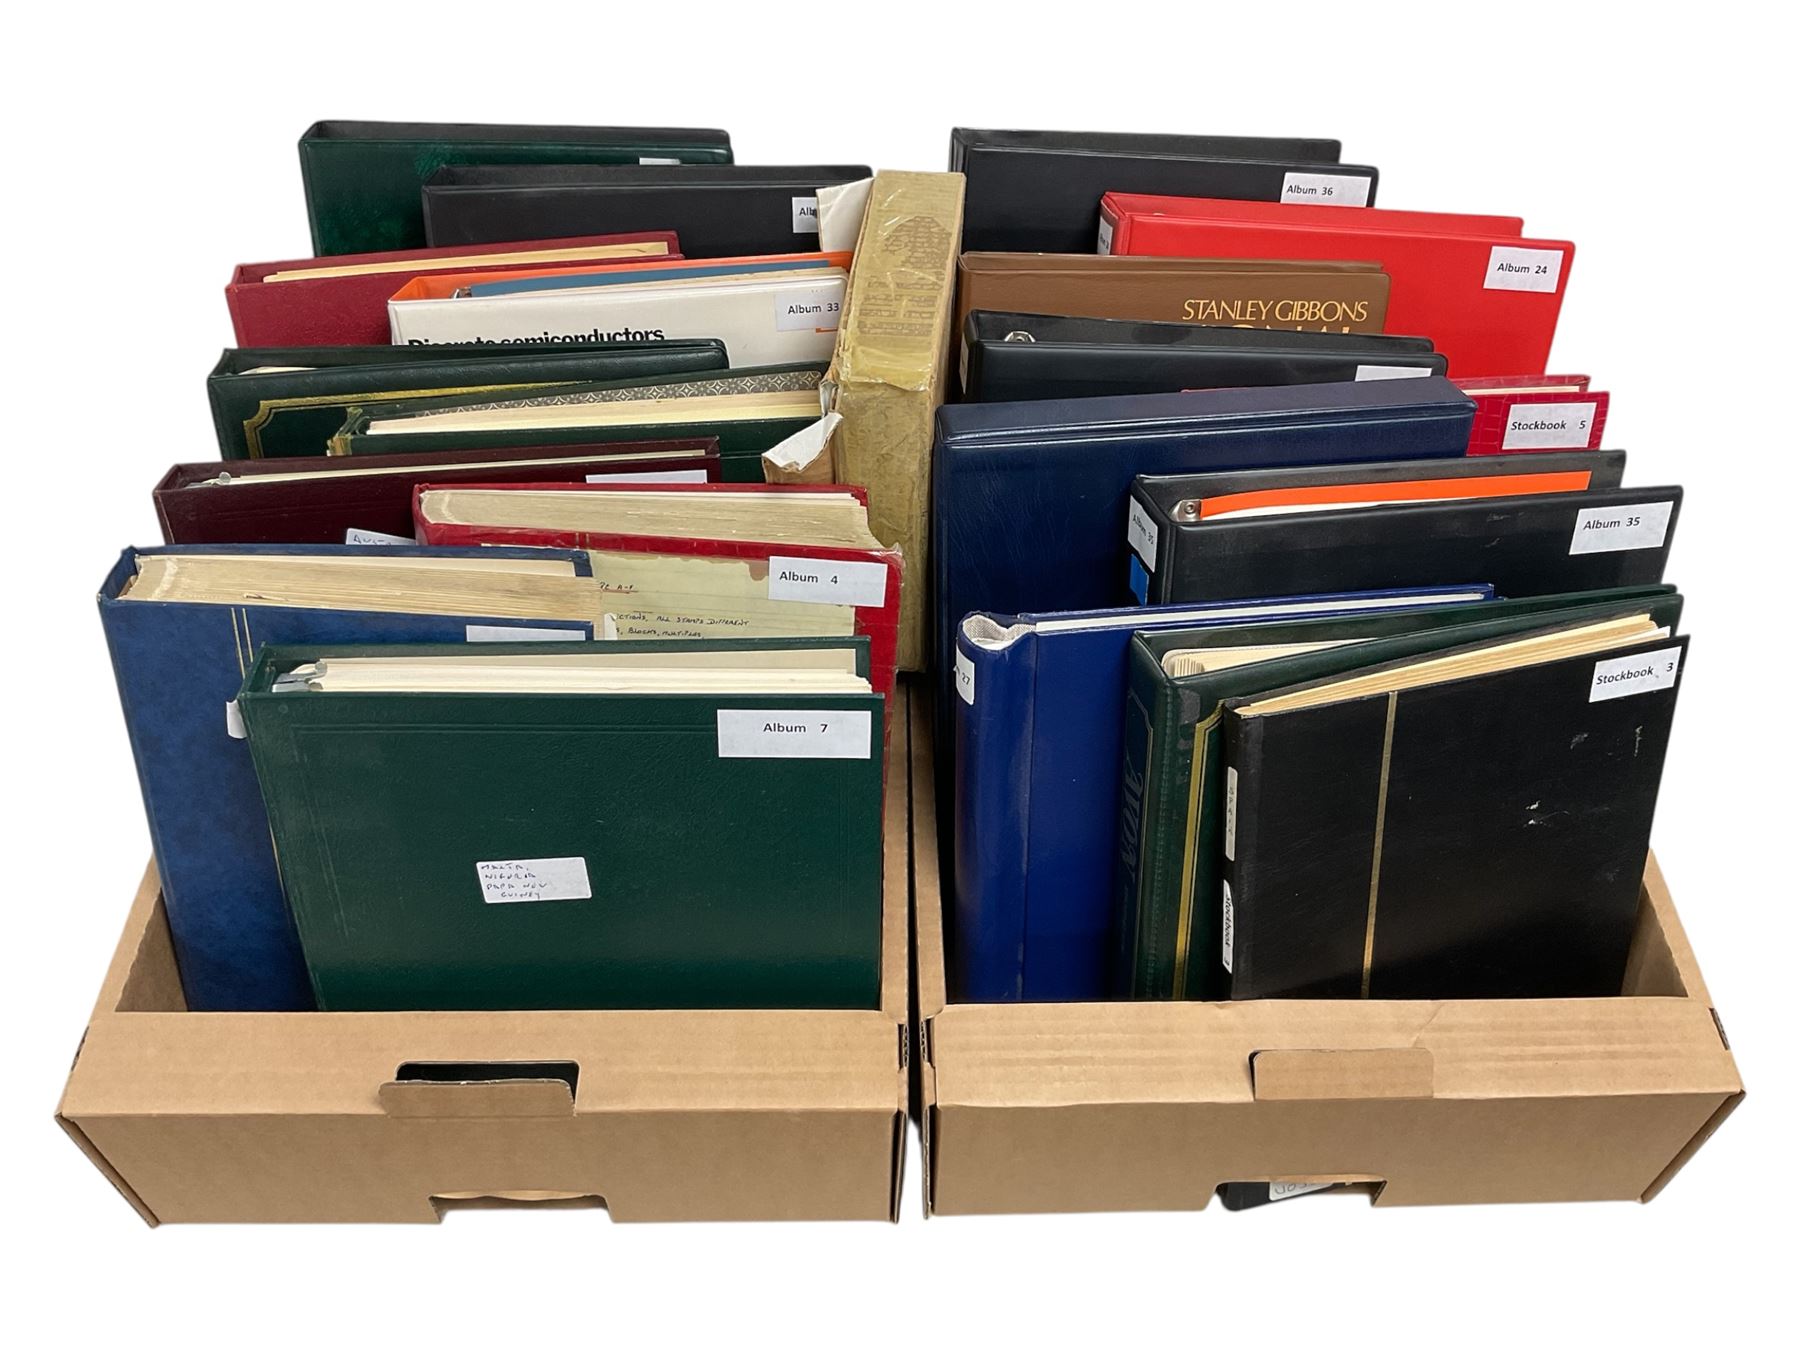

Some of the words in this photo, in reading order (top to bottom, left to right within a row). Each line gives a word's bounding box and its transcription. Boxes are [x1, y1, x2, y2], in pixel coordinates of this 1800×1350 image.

[1286, 184, 1317, 195] Album
[1321, 186, 1334, 196] 36
[1496, 262, 1530, 274] Album
[1534, 265, 1548, 274] 24
[787, 304, 822, 315] Album
[826, 302, 840, 312] 33
[1181, 298, 1274, 321] STANLEY
[1274, 299, 1369, 322] GIBBONS
[1510, 419, 1568, 431] Stockbook
[1578, 420, 1587, 430] 5
[1582, 519, 1621, 531] Album
[1625, 516, 1641, 527] 35
[778, 570, 819, 584] Album
[830, 575, 839, 585] 4
[1595, 665, 1655, 686] Stockbook
[1665, 661, 1675, 673] 3
[762, 722, 807, 734] Album
[819, 723, 829, 734] 7
